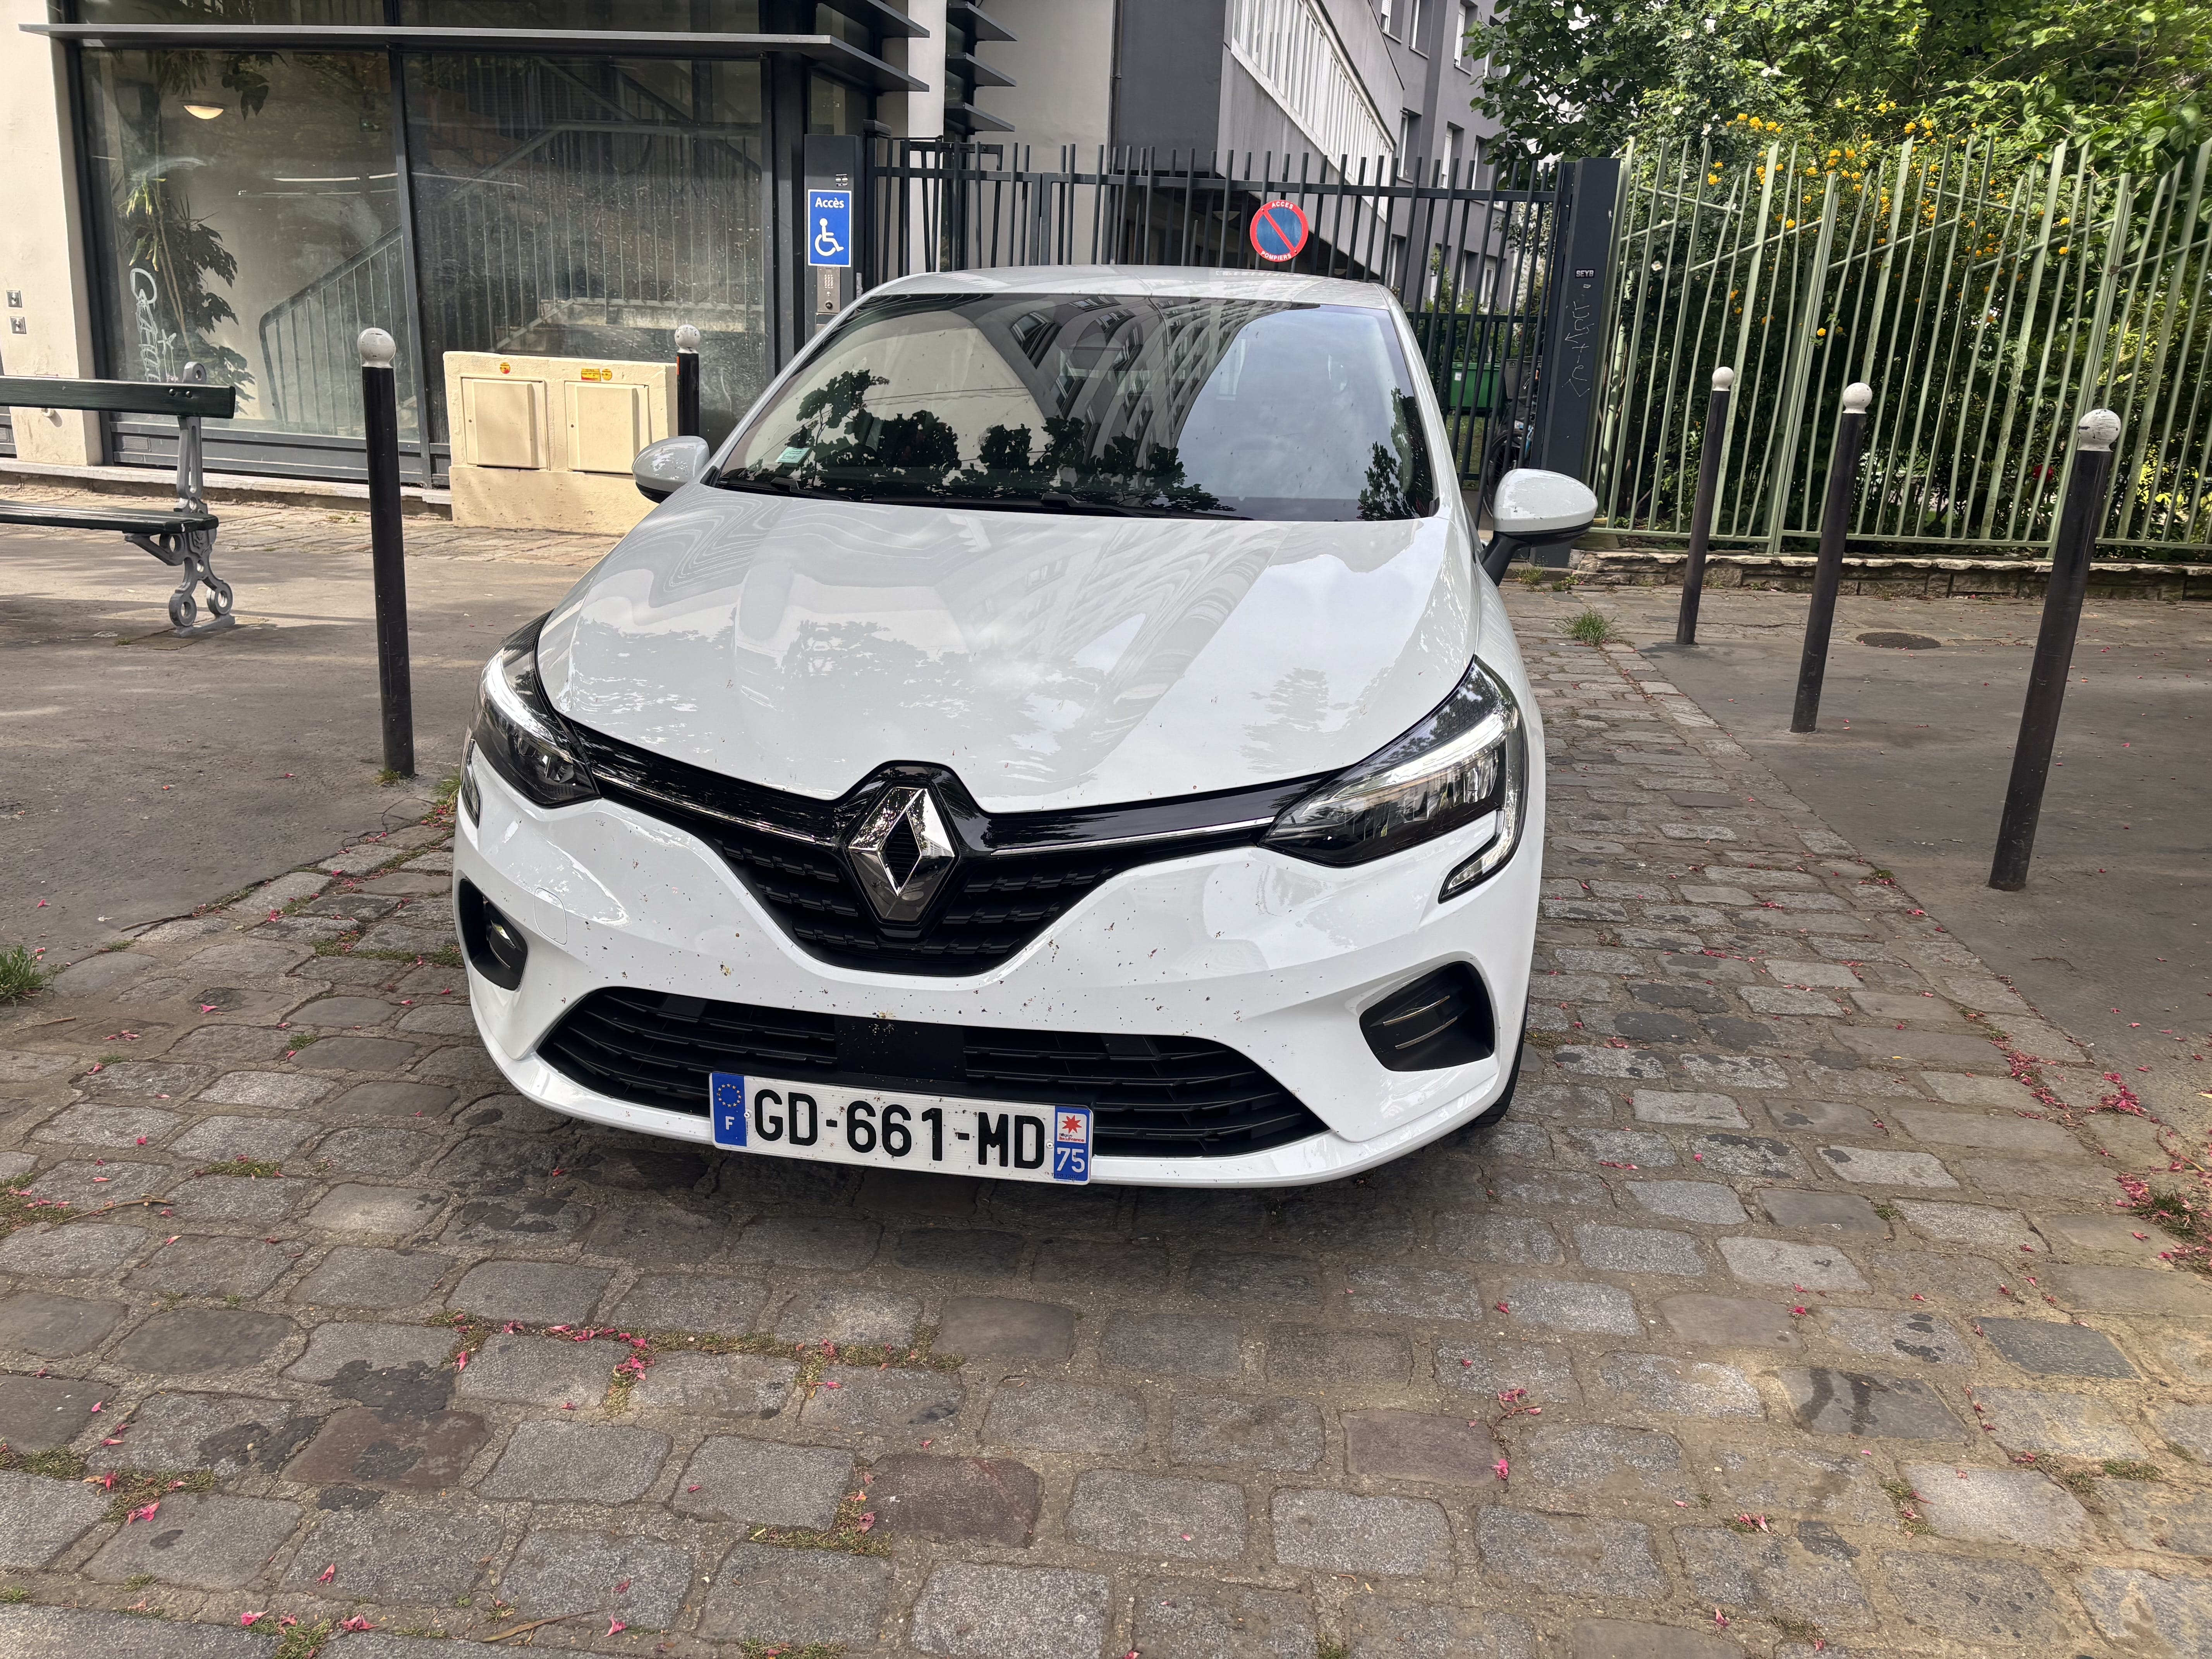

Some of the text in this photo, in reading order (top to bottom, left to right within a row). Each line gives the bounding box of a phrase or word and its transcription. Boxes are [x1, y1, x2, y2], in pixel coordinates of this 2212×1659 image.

[815, 197, 845, 208] Accès
[1272, 201, 1293, 210] ACCES
[1261, 251, 1292, 261] POMPIERS
[725, 1116, 734, 1130] F
[754, 1089, 1045, 1170] GD-661-MD
[1057, 1147, 1085, 1173] 75
